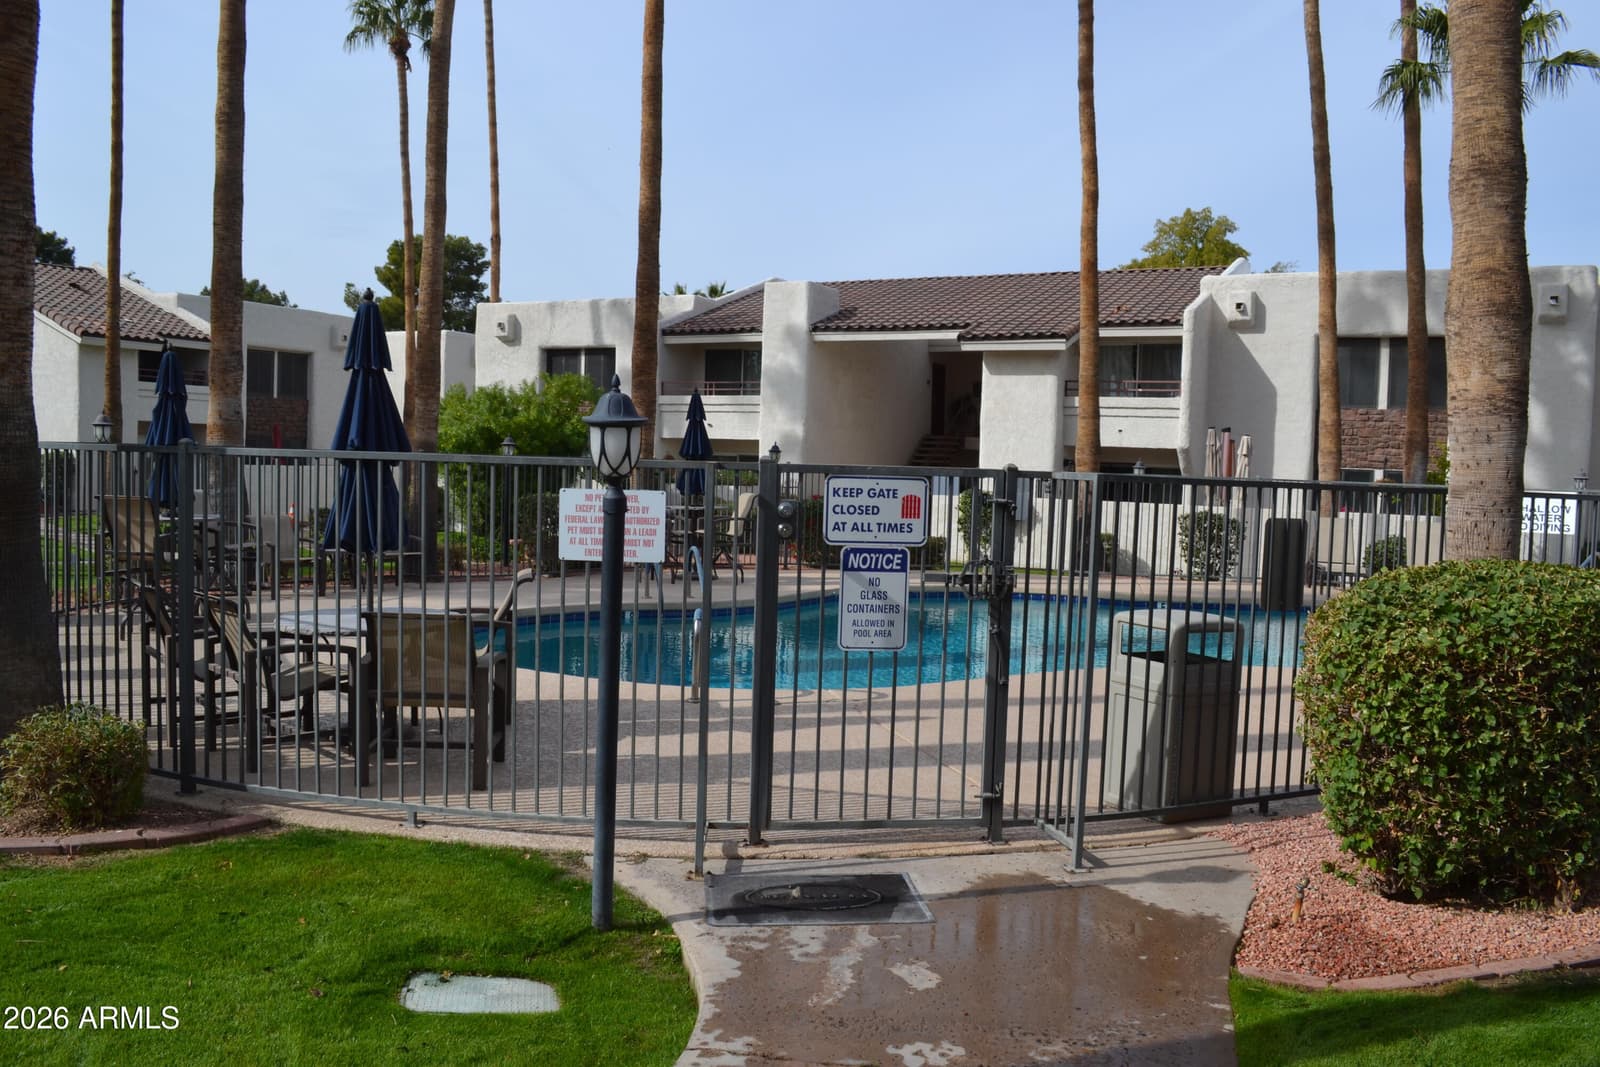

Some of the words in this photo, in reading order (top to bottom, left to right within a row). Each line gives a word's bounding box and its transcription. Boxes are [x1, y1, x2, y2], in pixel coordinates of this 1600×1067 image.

[832, 487, 864, 498] KEEP
[867, 488, 899, 499] GATE
[832, 504, 880, 515] CLOSED
[832, 522, 847, 532] AT
[851, 522, 873, 533] ALL
[876, 523, 913, 533] TIMES
[848, 553, 902, 569] NOTICE
[868, 577, 881, 587] NO
[860, 590, 888, 601] GLASS
[847, 603, 901, 614] CONTAINERS
[852, 619, 886, 628] ALLOWED
[887, 620, 895, 628] IN
[853, 629, 872, 638] POOL
[873, 629, 892, 638] AREA
